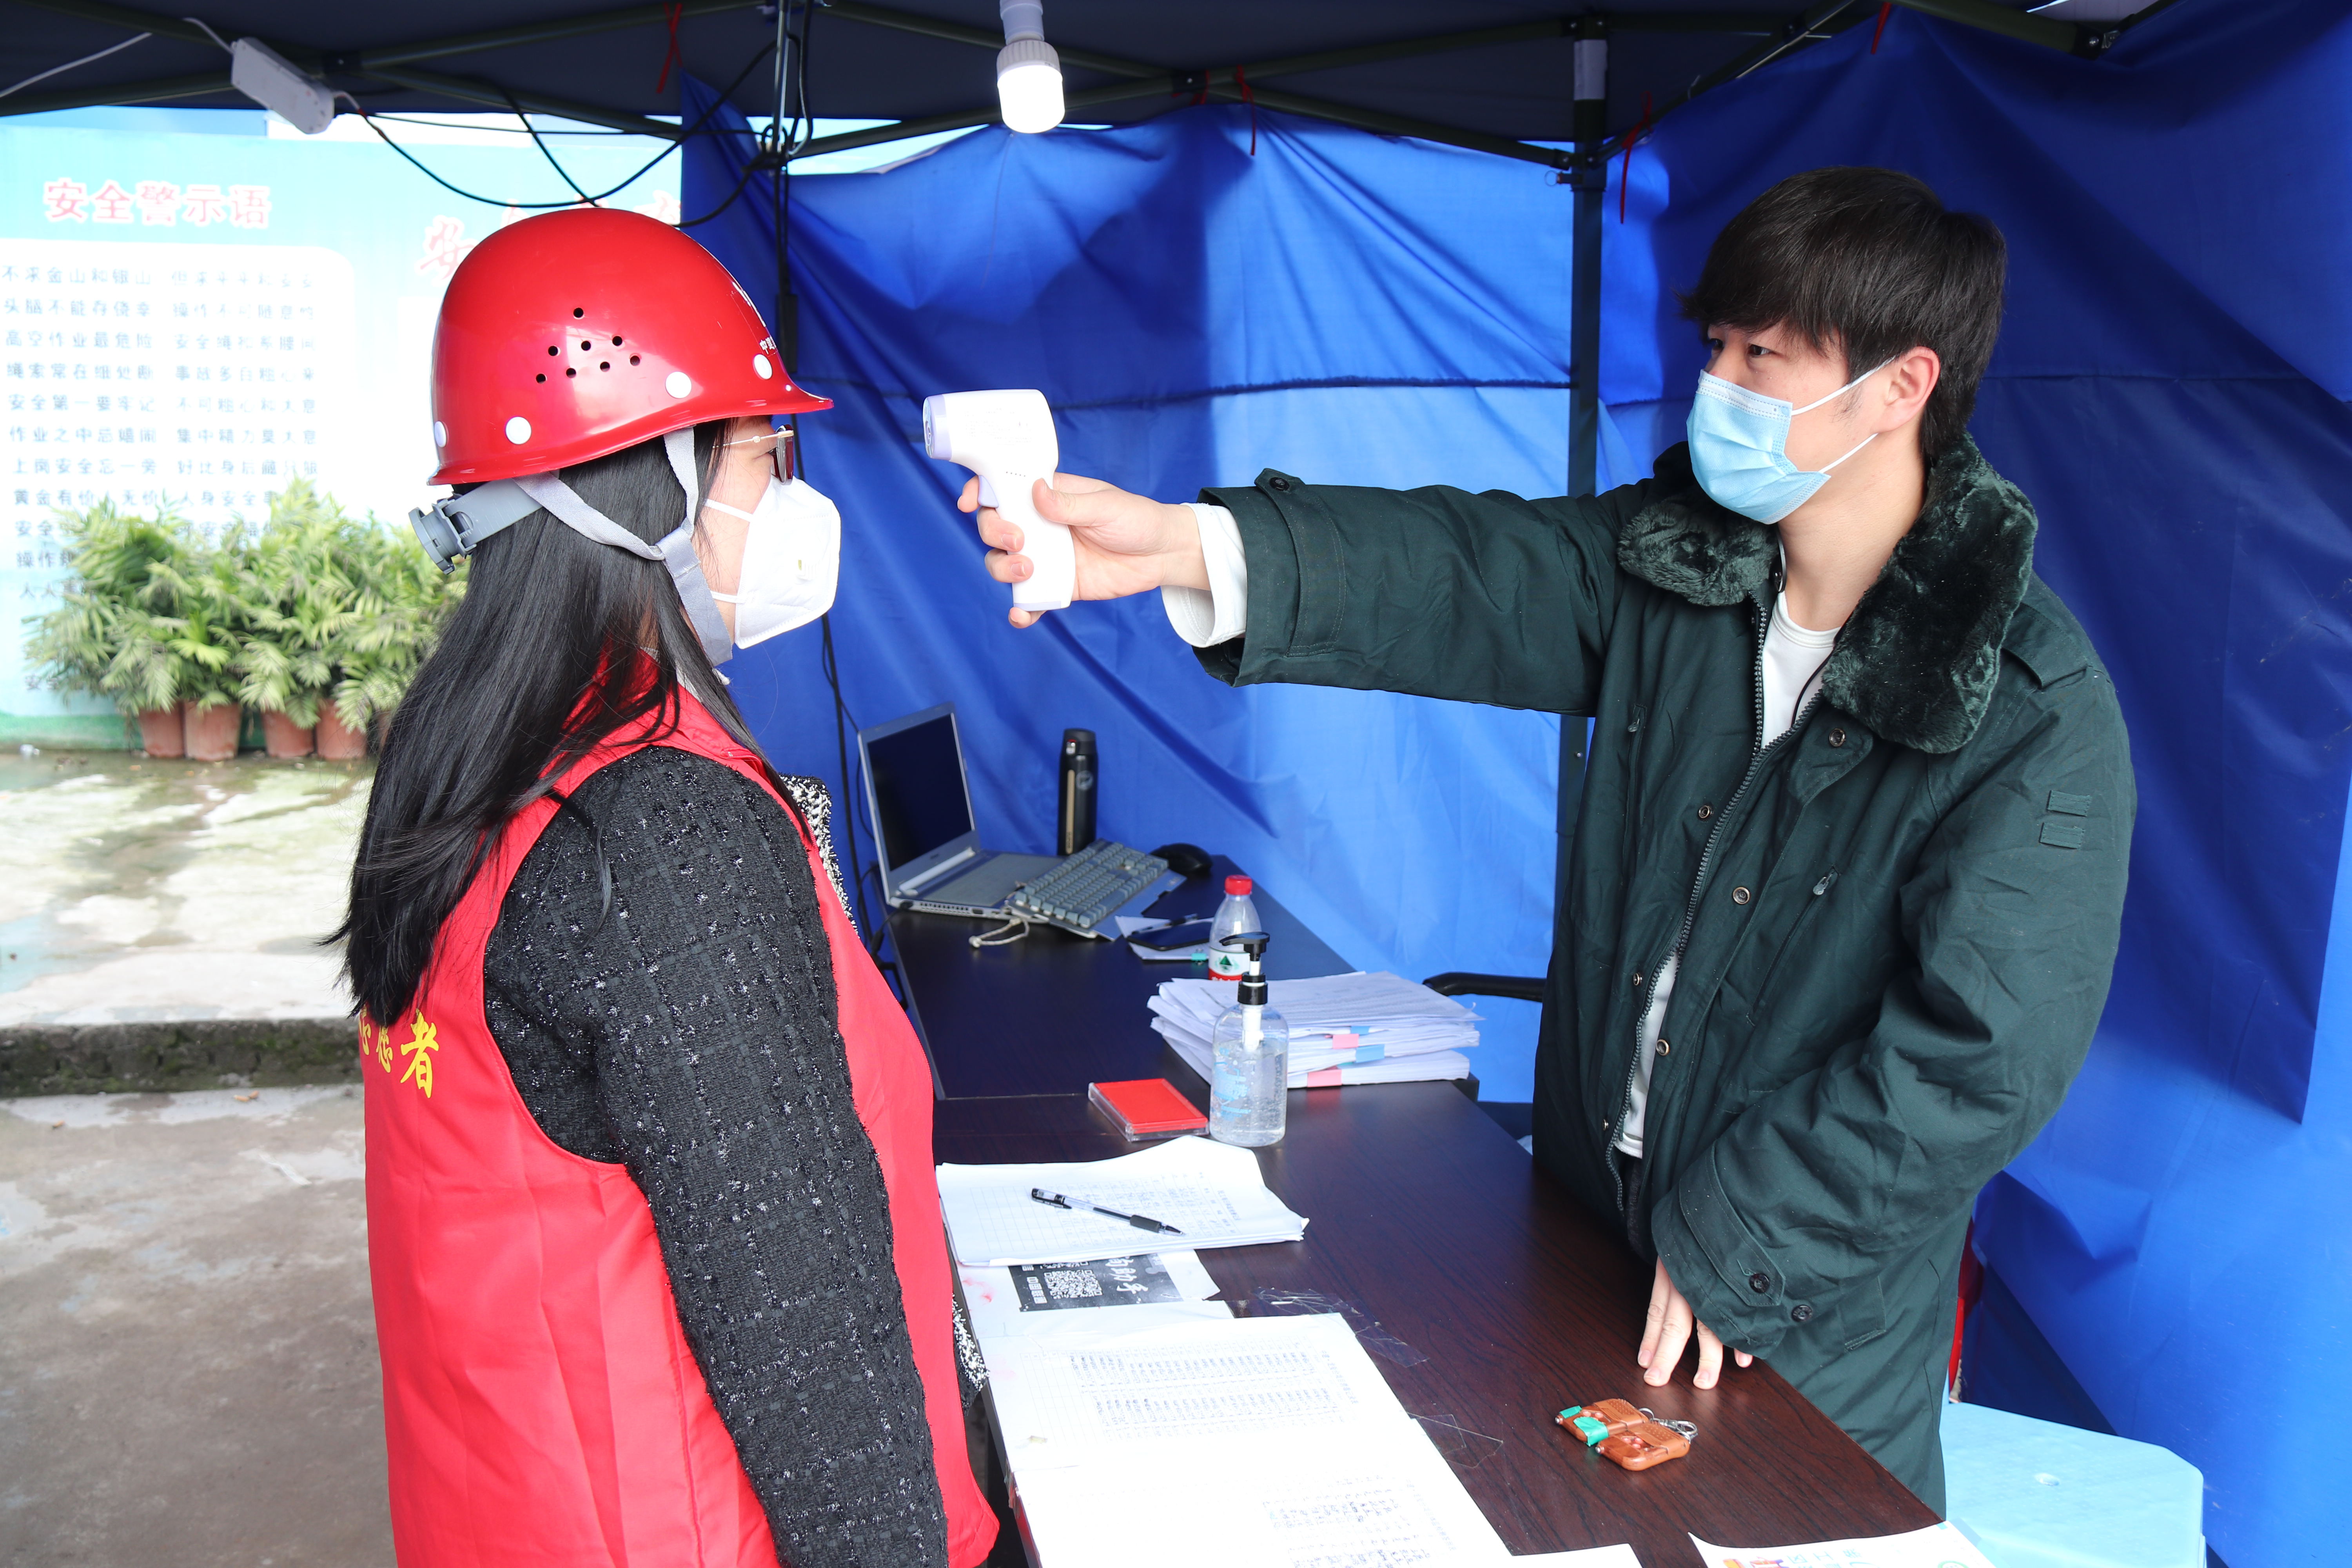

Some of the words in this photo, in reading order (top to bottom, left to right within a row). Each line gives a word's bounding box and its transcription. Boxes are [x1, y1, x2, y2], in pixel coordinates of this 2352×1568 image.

[47, 181, 271, 225] 安全警示语
[2, 265, 151, 285] 不求金山和银山
[4, 297, 151, 318] 头脑不能存侥幸
[5, 329, 153, 349] 高空作业最危险
[6, 361, 153, 381] 绳索常在细处断
[8, 393, 155, 412] 安全第一要牢记
[176, 396, 317, 414] 不可粗心和大意
[9, 425, 157, 444] 作业之中忌嬉闹
[176, 427, 317, 445] 集中精力莫大意
[13, 457, 157, 475] 上岗安全忘一旁
[14, 488, 158, 506] 黄金有价无价
